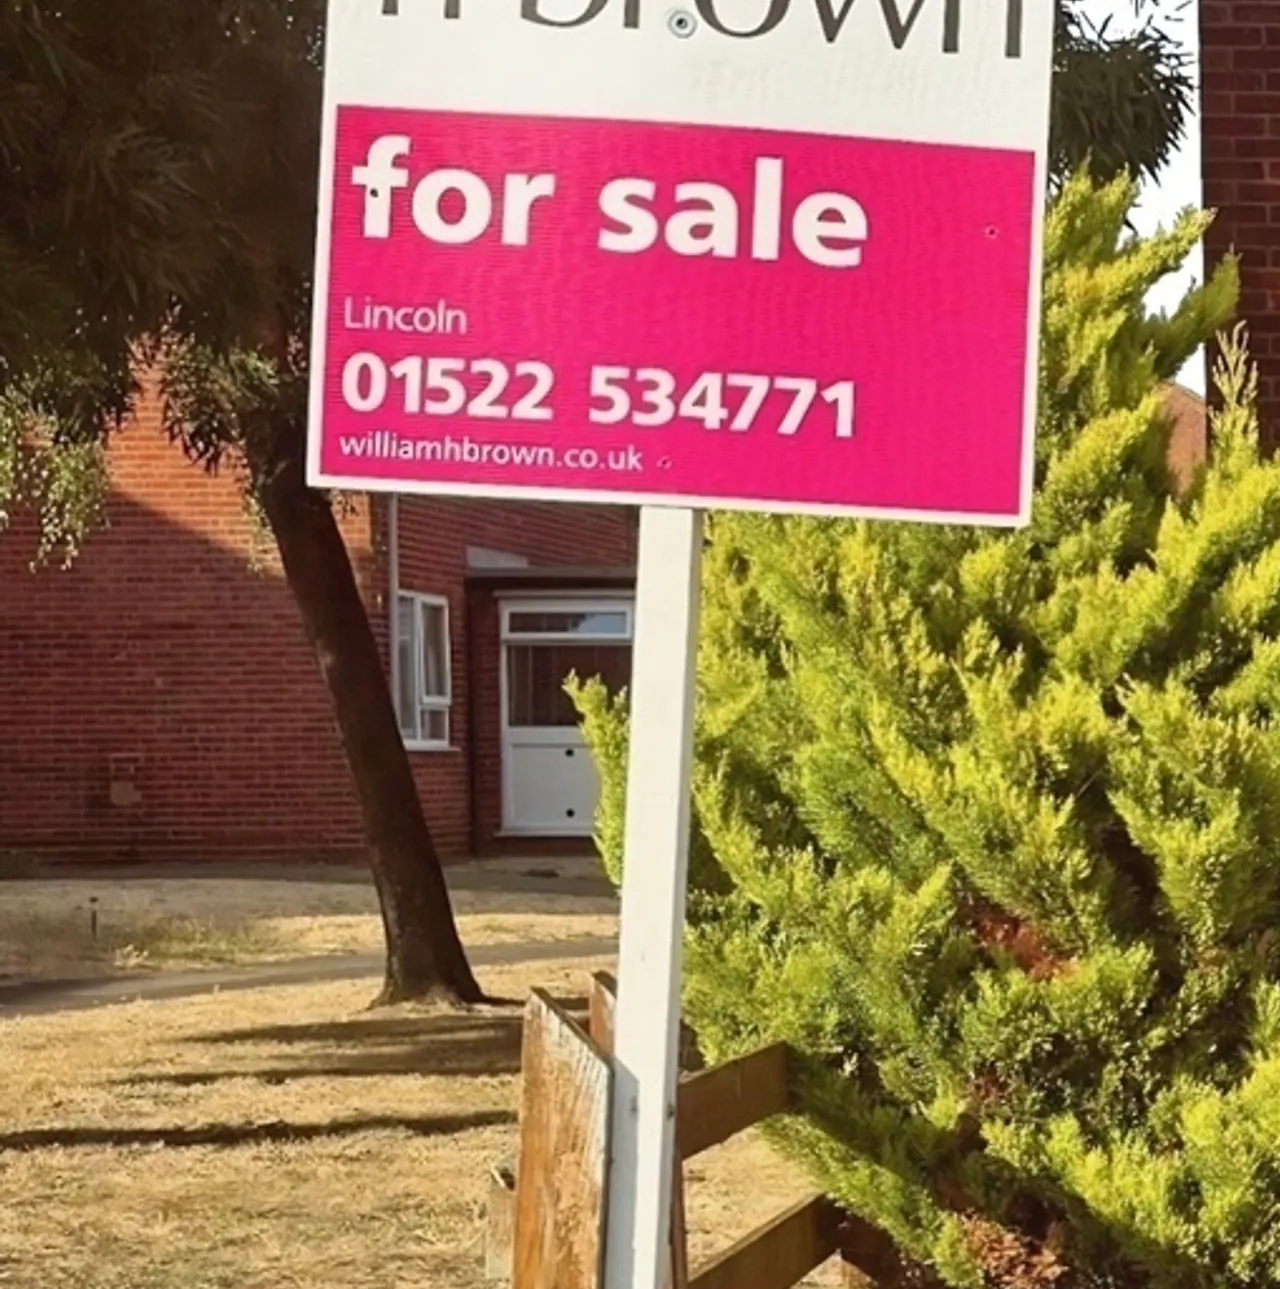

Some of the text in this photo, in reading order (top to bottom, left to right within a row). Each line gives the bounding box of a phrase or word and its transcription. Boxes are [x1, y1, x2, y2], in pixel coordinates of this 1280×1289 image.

[351, 134, 869, 268] for sale
[343, 296, 467, 335] Lincoln
[341, 352, 855, 438] 01522 534771
[339, 429, 643, 472] williamhbrown.co.uk
